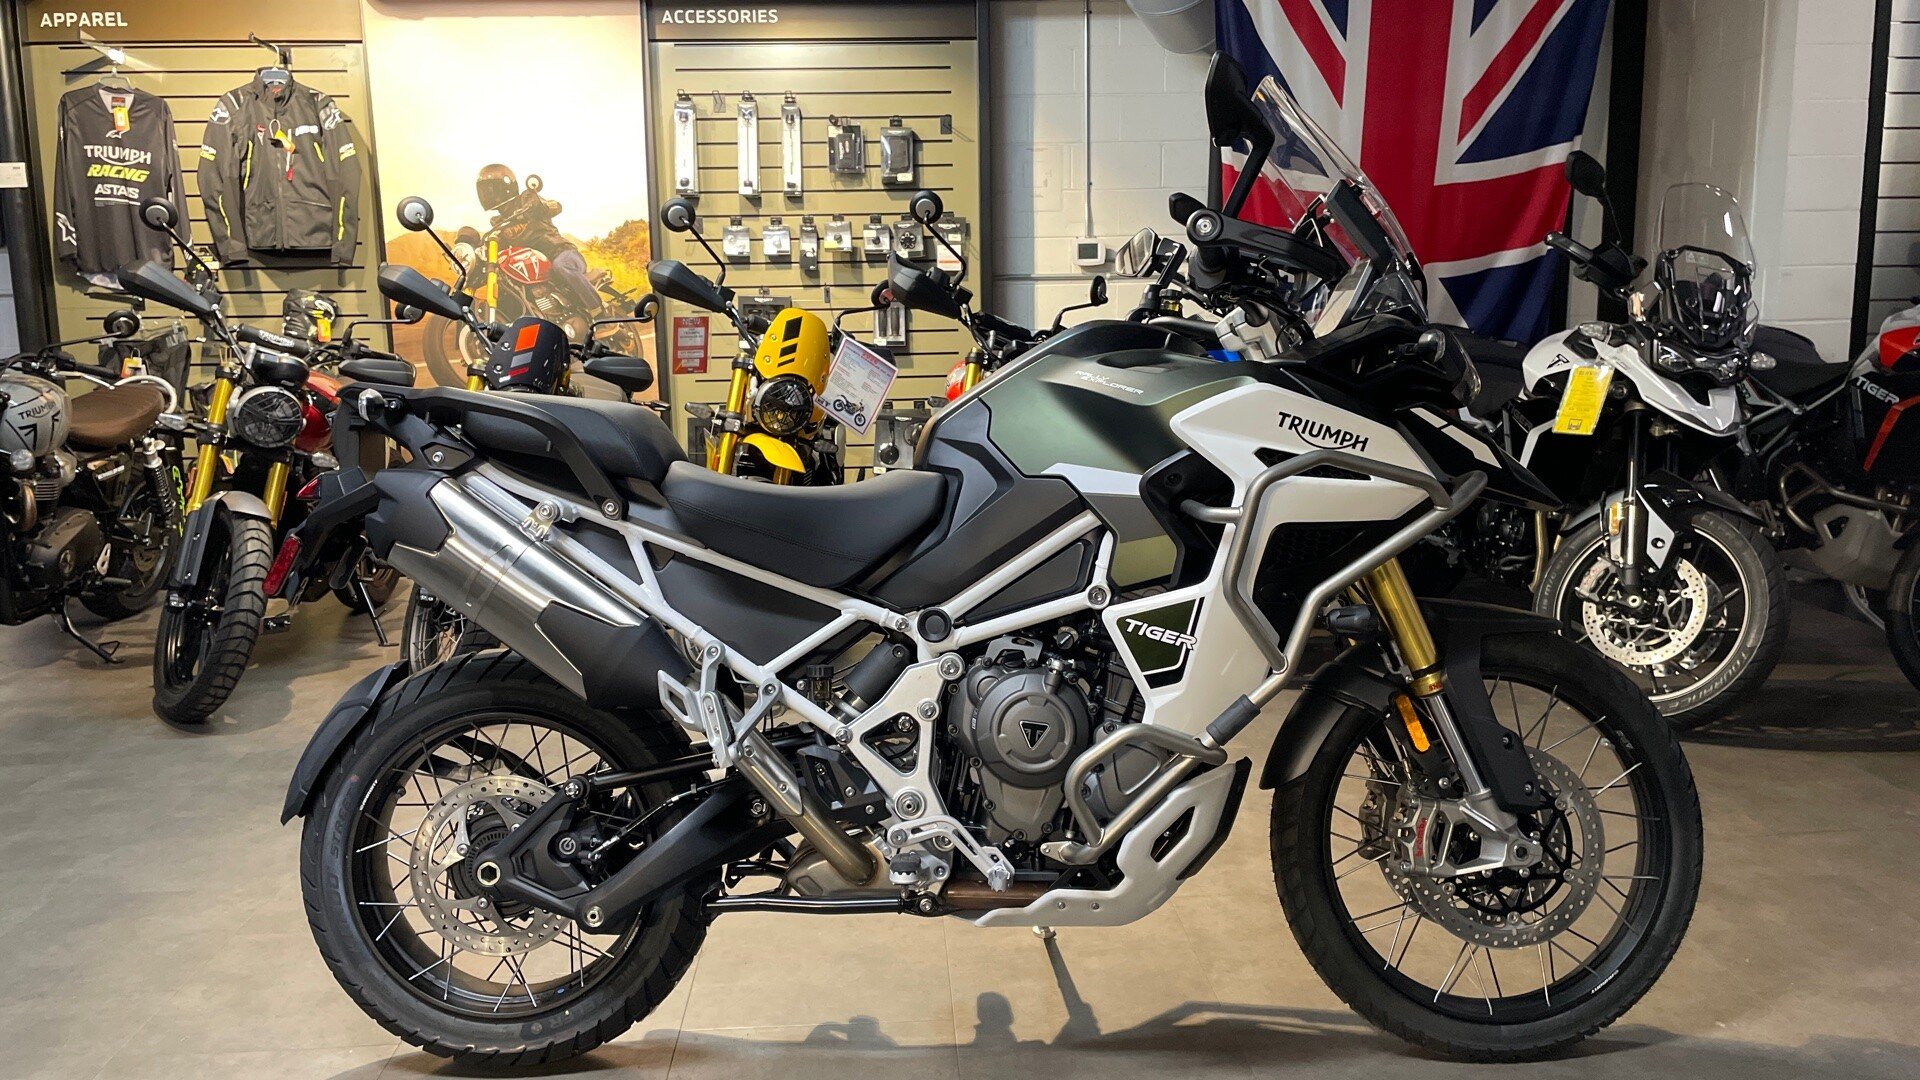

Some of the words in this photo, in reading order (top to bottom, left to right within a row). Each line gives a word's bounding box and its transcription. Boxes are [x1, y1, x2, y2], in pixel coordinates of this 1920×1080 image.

[40, 11, 128, 28] APPAREL
[661, 9, 779, 24] ACCESSORIES
[83, 144, 152, 166] TRIUMPH
[87, 163, 150, 183] RACNG
[1856, 376, 1900, 404] TIGER
[1278, 411, 1369, 452] TRIUMPH
[1125, 618, 1198, 650] TIGER
